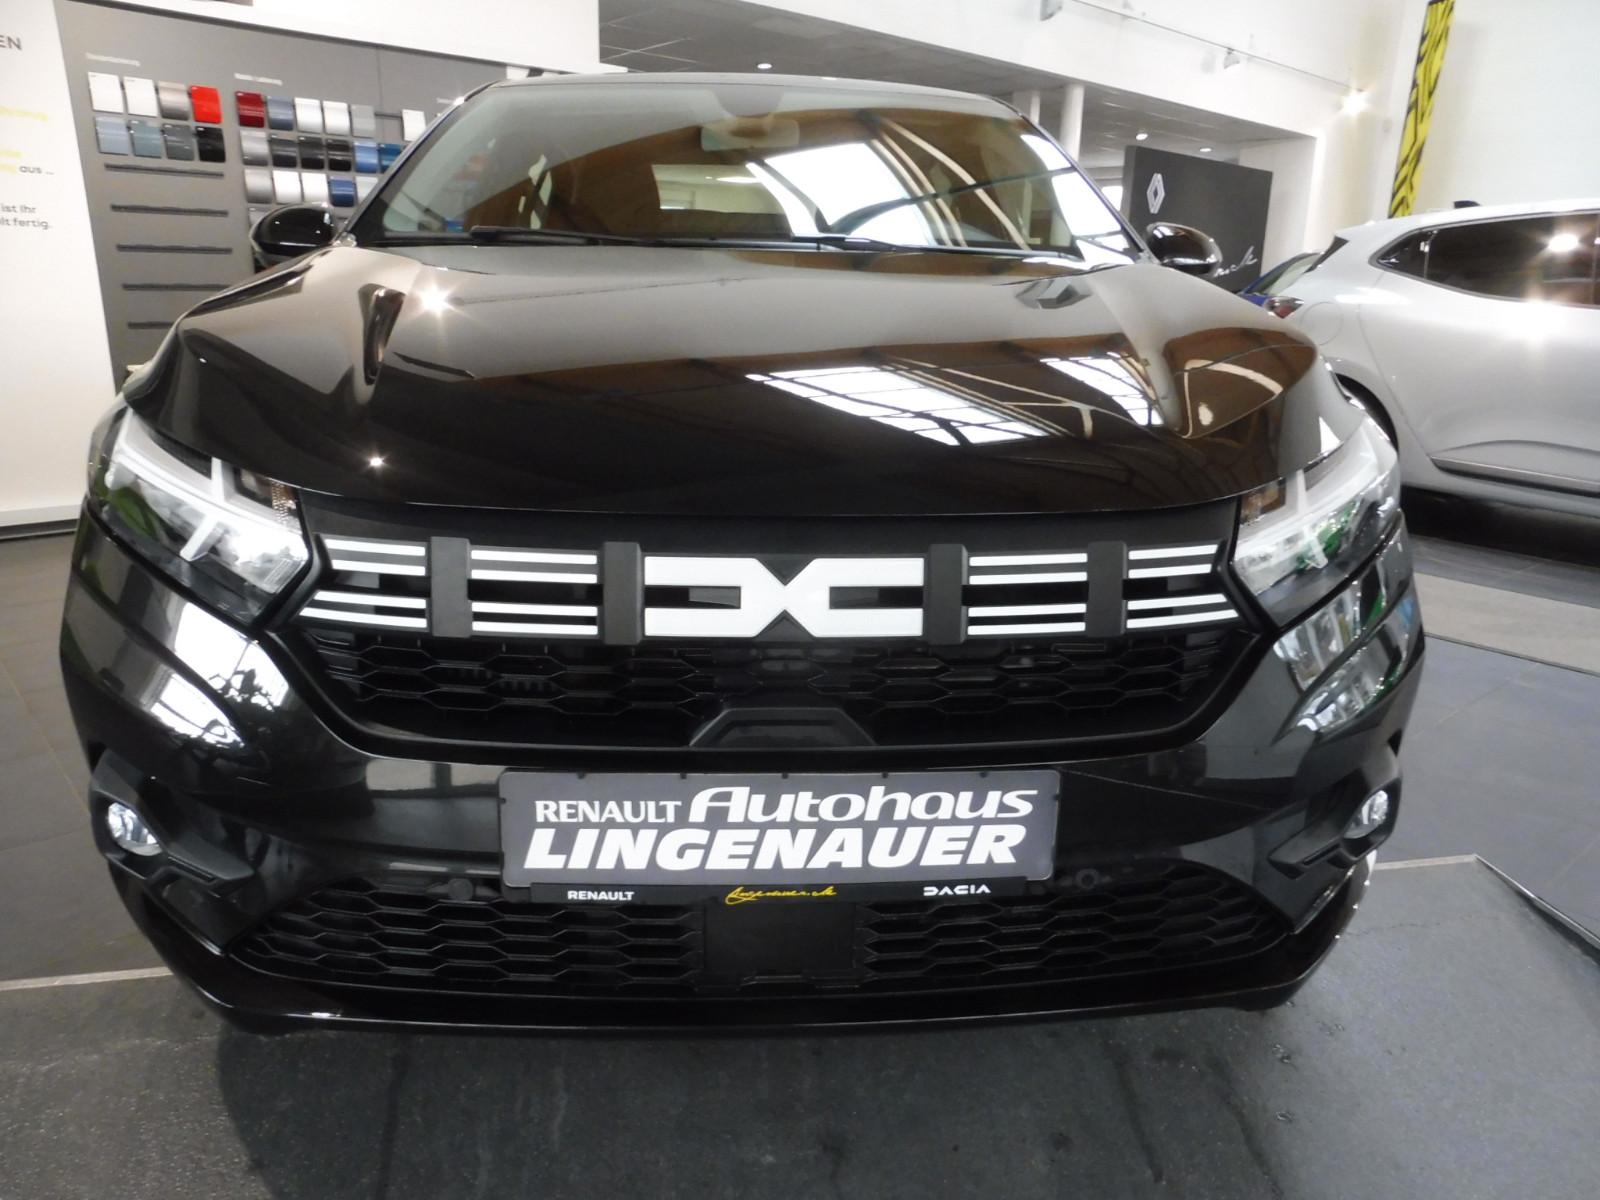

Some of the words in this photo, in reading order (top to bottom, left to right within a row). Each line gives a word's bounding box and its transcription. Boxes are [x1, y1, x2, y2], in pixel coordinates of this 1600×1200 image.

[534, 799, 683, 825] RENAULT
[687, 785, 1038, 823] Autohaus
[523, 823, 1027, 870] LINGENAUER
[566, 889, 636, 902] RENAULT
[922, 883, 992, 897] DACIA
